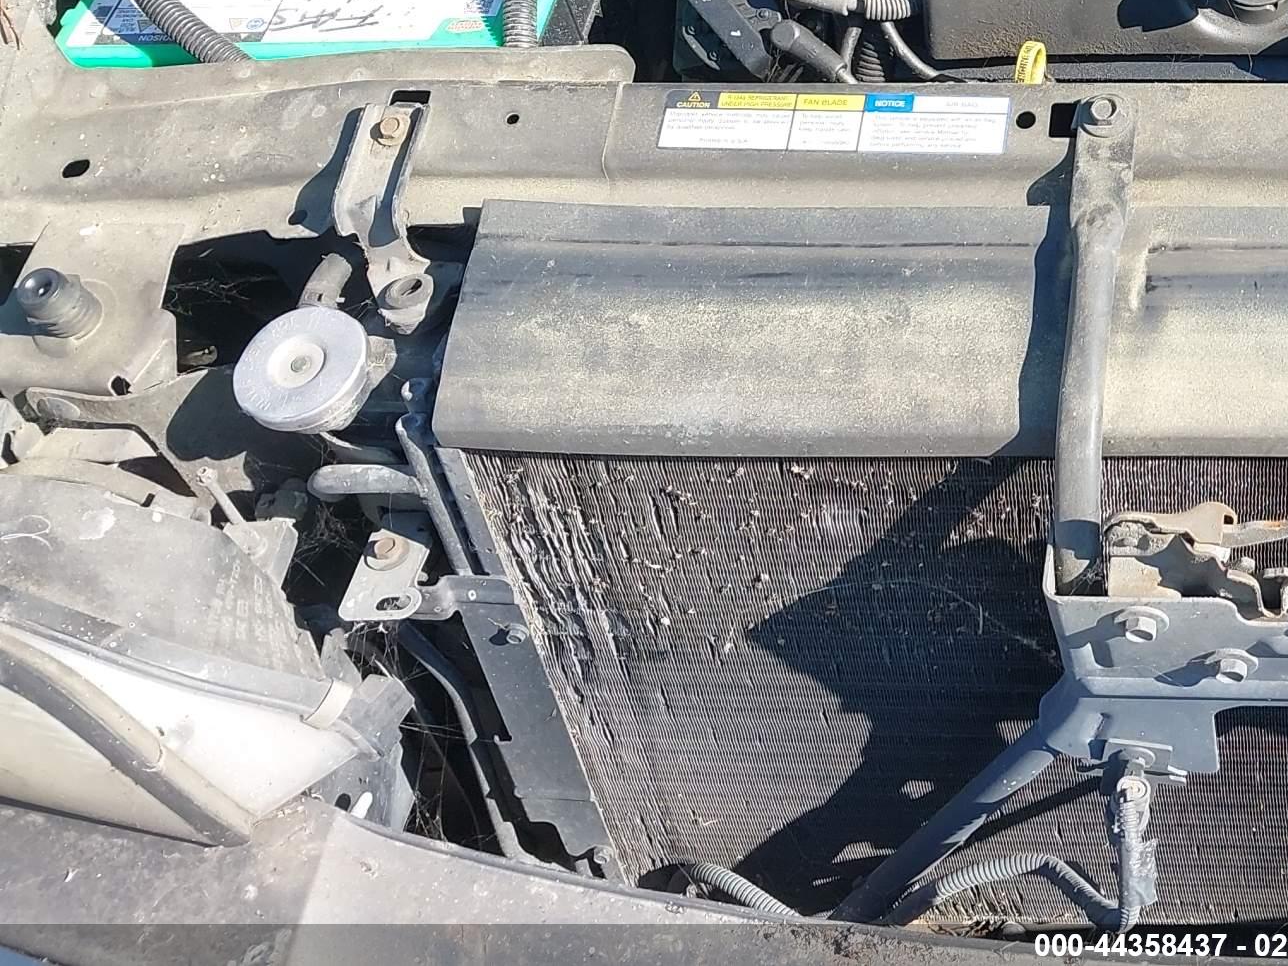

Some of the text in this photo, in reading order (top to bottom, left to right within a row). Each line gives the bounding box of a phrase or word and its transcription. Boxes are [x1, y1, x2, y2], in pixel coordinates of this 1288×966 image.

[730, 30, 742, 38] 1
[676, 101, 711, 109] CAUTION
[760, 101, 793, 109] PRESSURE
[803, 98, 820, 106] FAN
[874, 99, 906, 108] NOTICE
